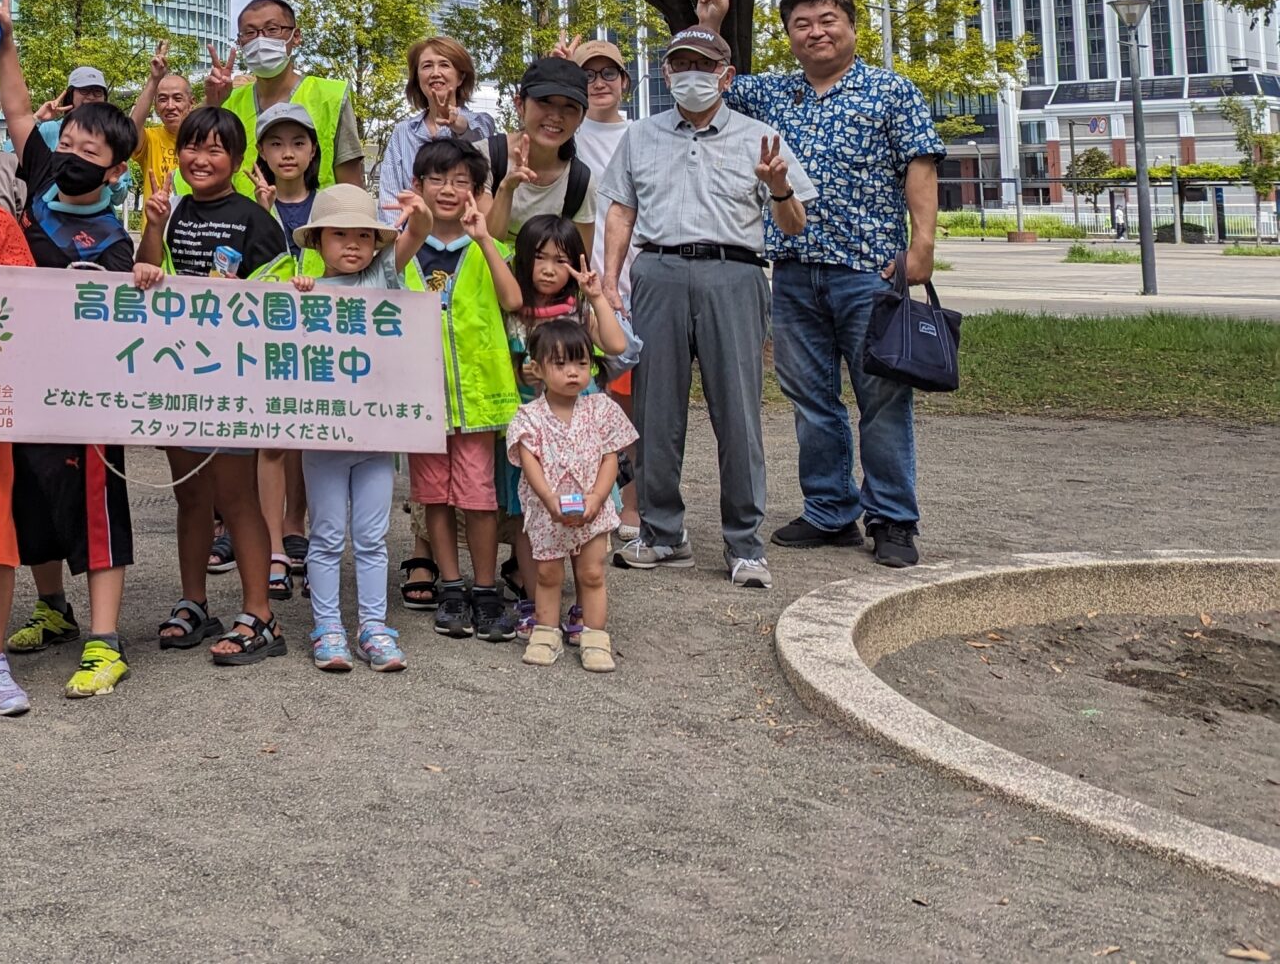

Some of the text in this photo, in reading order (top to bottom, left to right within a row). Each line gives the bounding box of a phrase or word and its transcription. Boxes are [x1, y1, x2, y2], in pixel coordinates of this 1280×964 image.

[74, 281, 403, 337] 高島中央公園愛護会
[116, 337, 371, 383] イベント開催中
[43, 388, 432, 421] どなたでもご参加頂けます、道具は用意しています。
[130, 419, 353, 443] スタッフにお声かけください。
